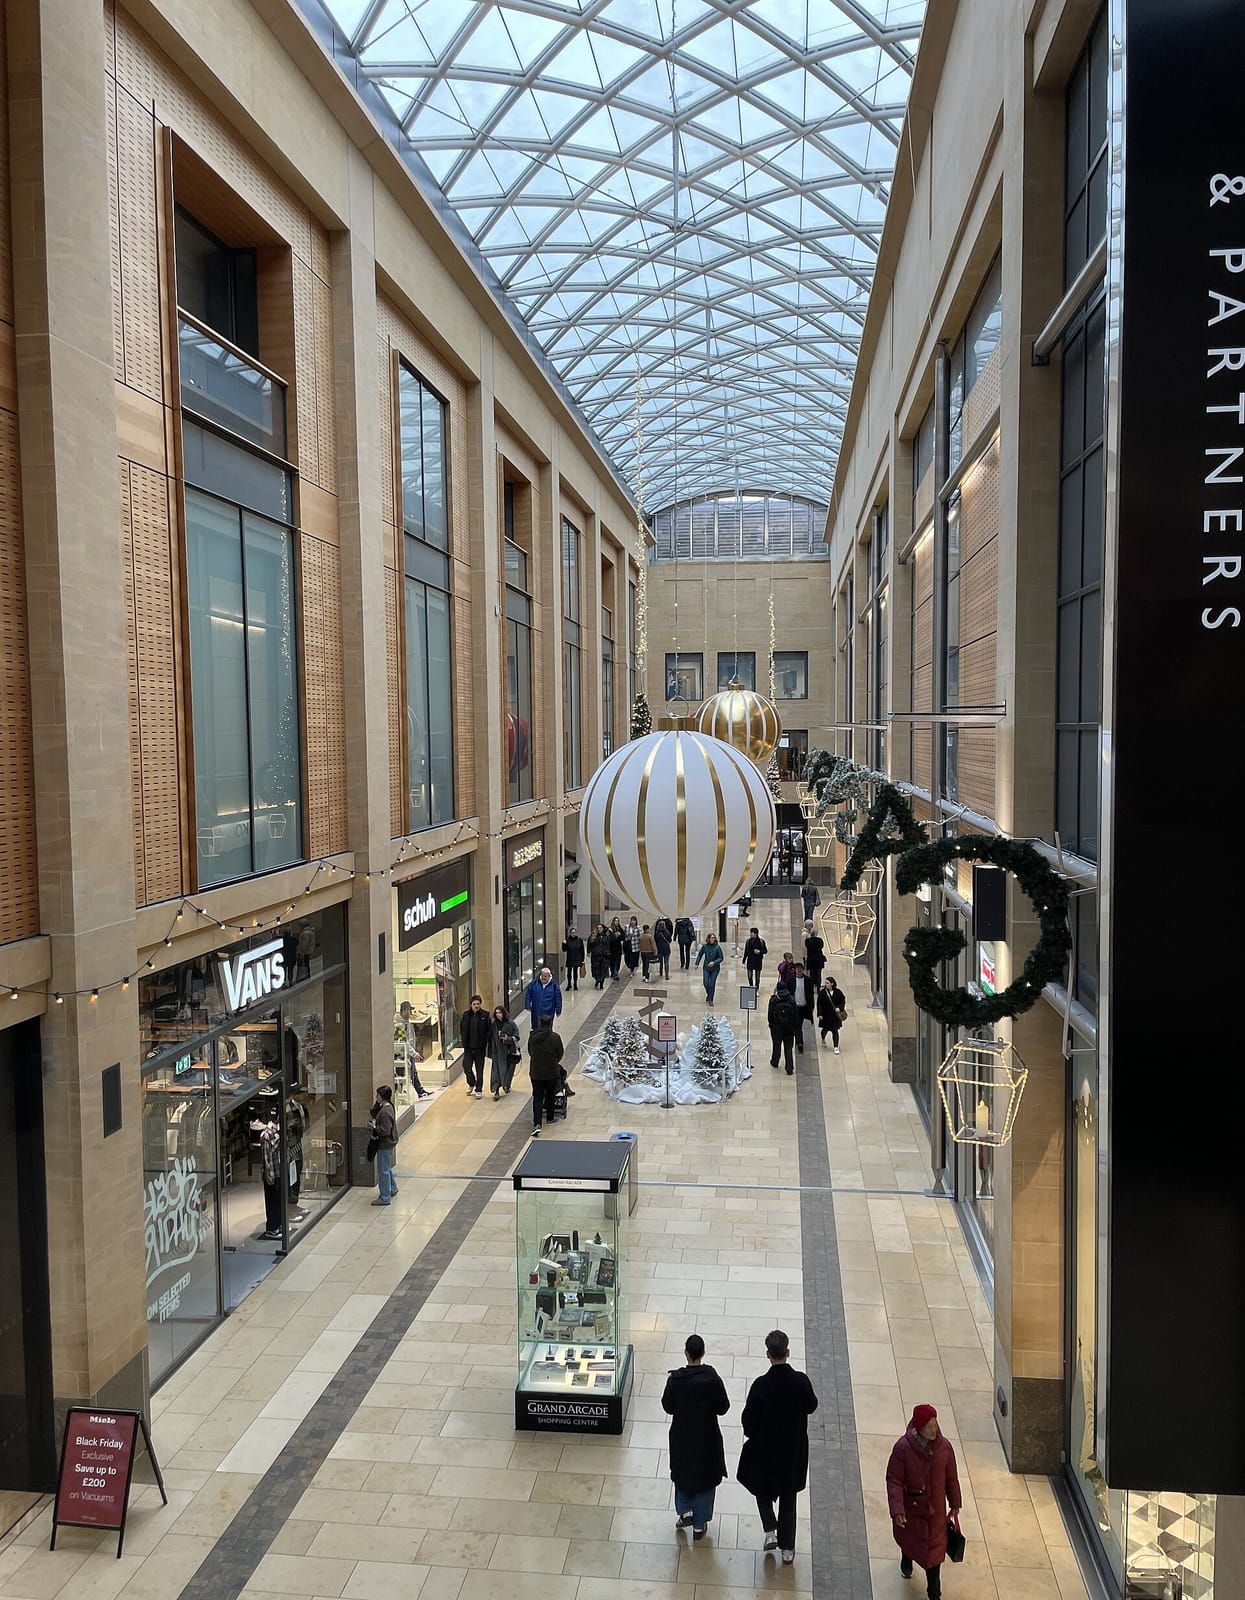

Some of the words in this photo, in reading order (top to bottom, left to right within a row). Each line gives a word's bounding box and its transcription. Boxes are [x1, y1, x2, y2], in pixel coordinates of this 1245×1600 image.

[1209, 172, 1245, 208] &
[1200, 247, 1245, 630] PARTNERS
[403, 892, 436, 931] schuh
[222, 938, 285, 1011] VANS
[147, 1302, 158, 1321] ON
[158, 1271, 192, 1311] SELECTED
[159, 1295, 180, 1324] ITEMS
[527, 1402, 566, 1414] GRAND
[567, 1404, 609, 1416] ARCADE
[89, 1415, 116, 1424] Miele
[537, 1417, 571, 1425] SHOPPING
[573, 1418, 599, 1427] CENTRE
[76, 1436, 98, 1447] Black
[99, 1438, 123, 1450] Friday
[81, 1450, 114, 1461] Exclusive
[75, 1463, 94, 1474] Save
[96, 1466, 106, 1475] up
[108, 1466, 117, 1475] to
[82, 1477, 106, 1488] £200
[81, 1491, 115, 1503] Vacuums
